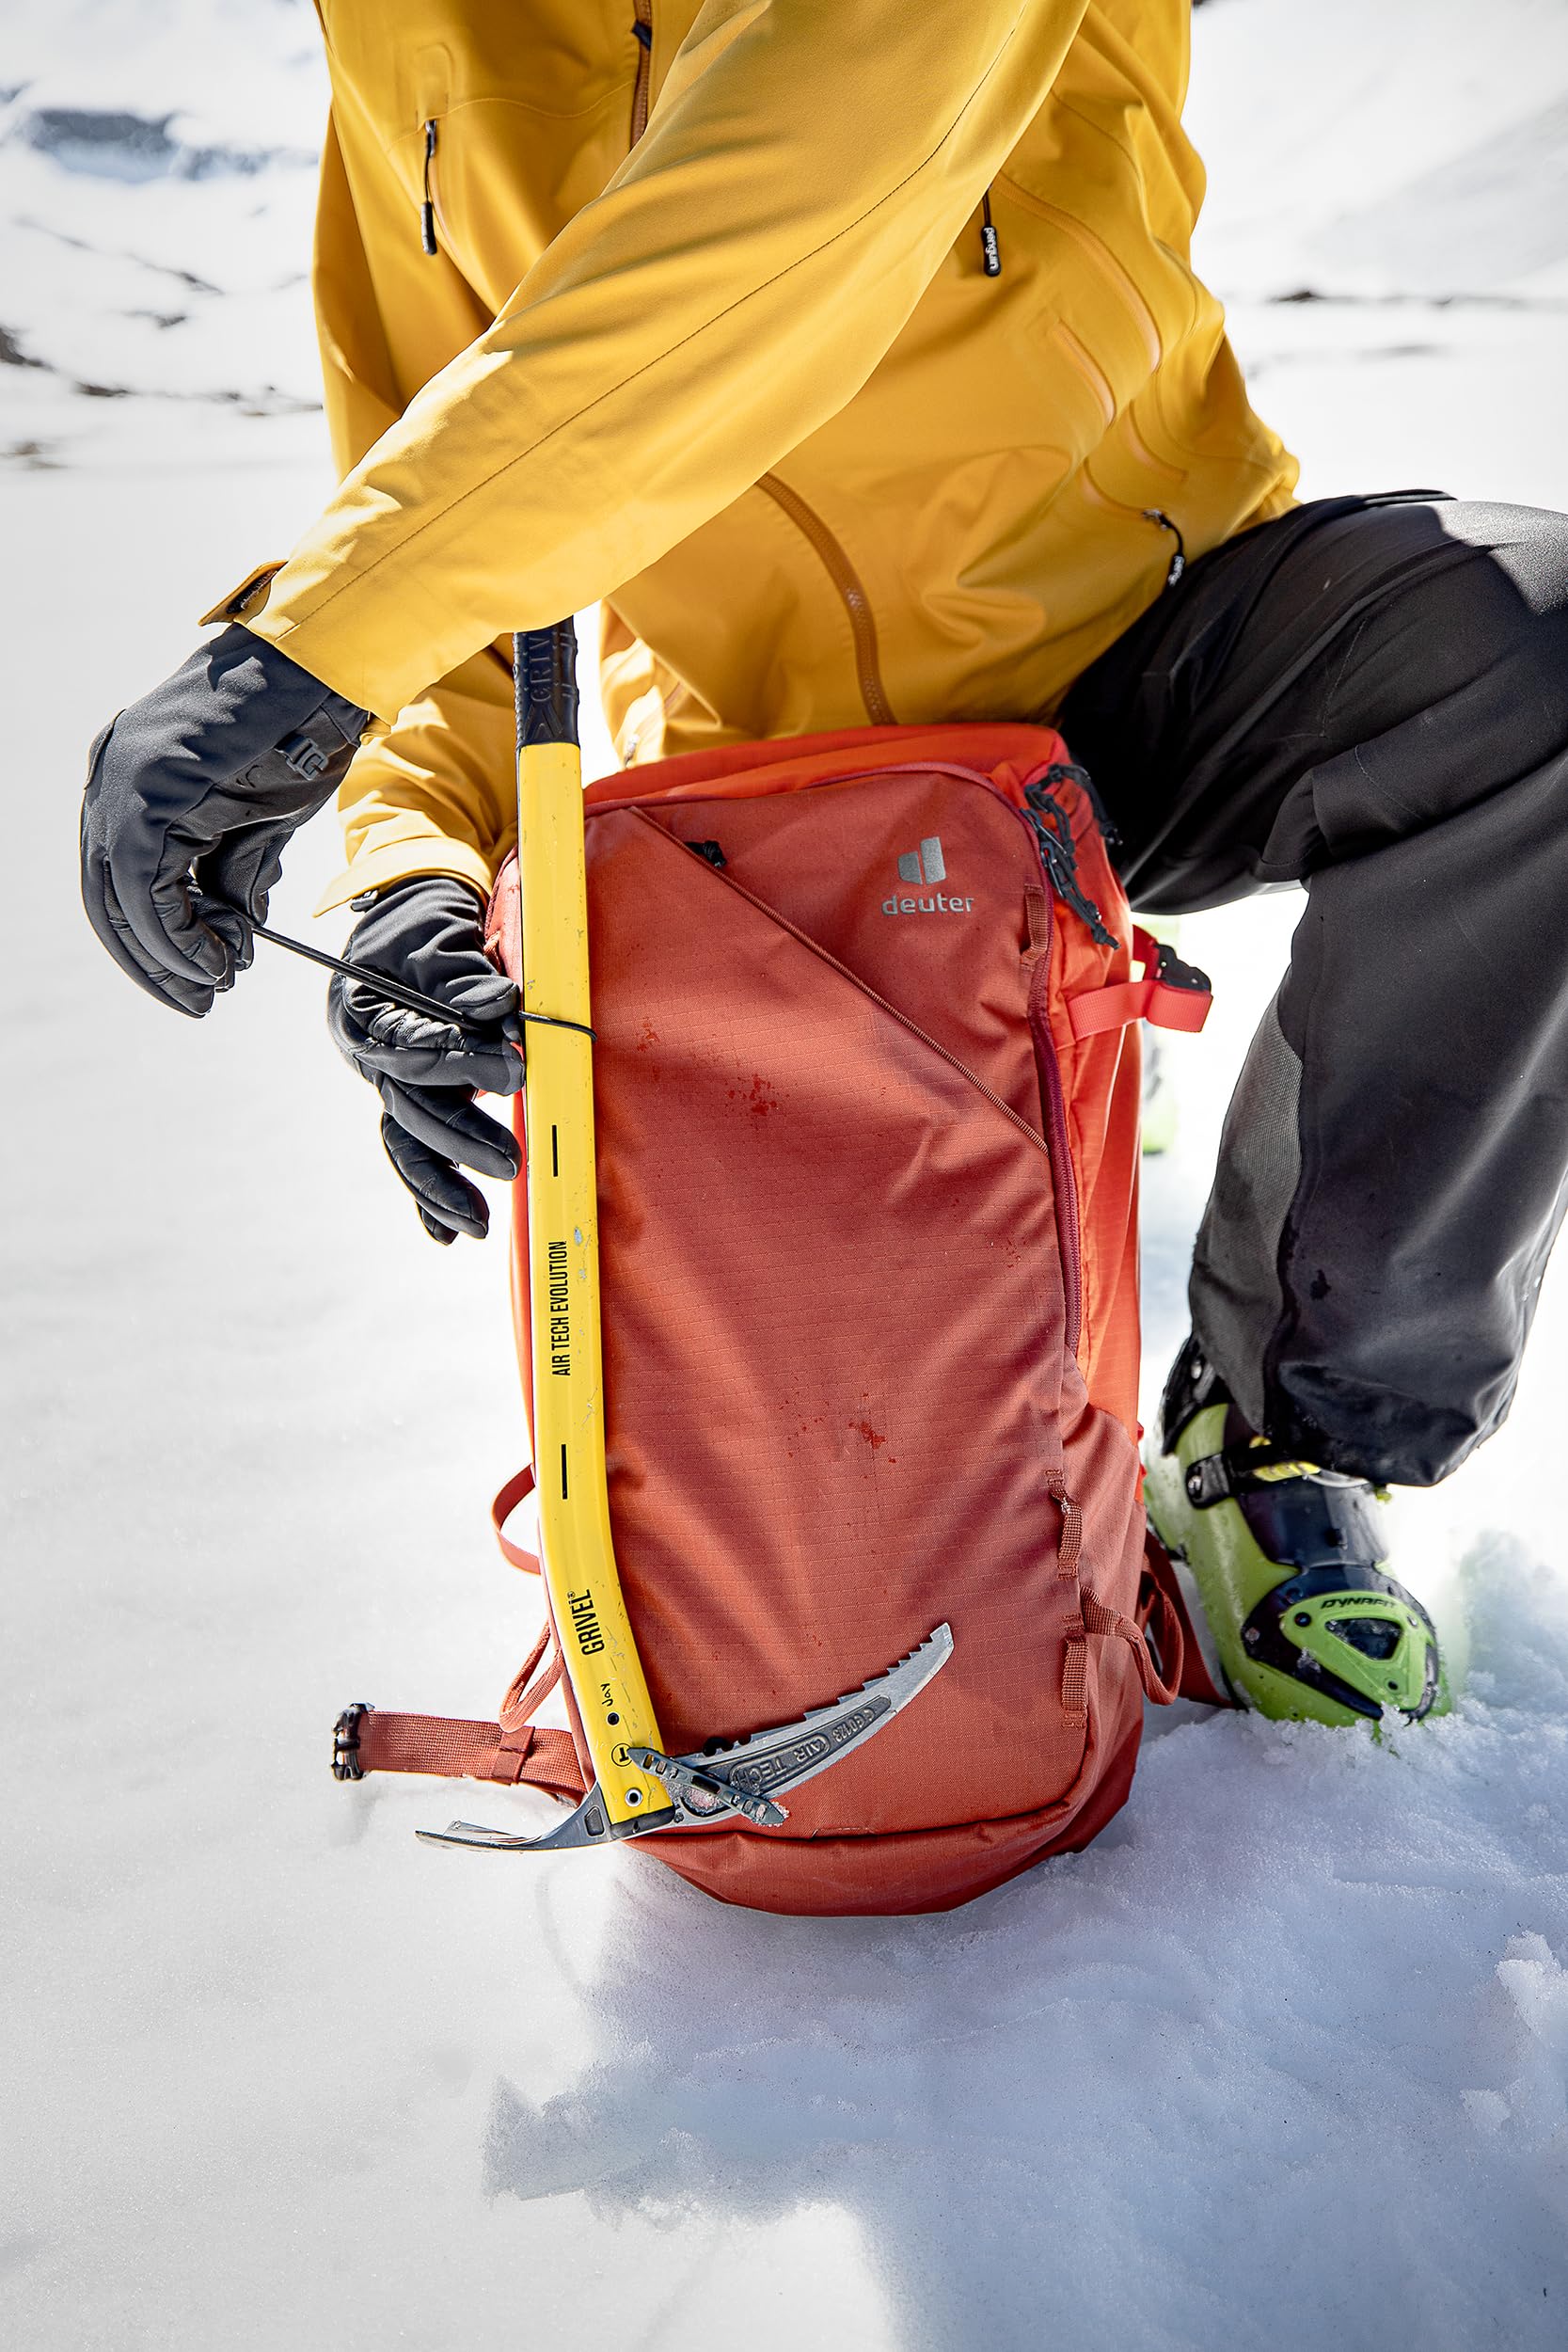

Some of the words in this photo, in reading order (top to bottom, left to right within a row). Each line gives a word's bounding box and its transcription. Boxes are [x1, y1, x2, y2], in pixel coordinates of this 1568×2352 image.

[983, 227, 999, 271] penguin
[529, 636, 551, 702] GRIV
[881, 892, 974, 915] deuter
[548, 1240, 569, 1312] EVOLUTION
[550, 1316, 570, 1351] TECH
[551, 1354, 571, 1376] AIR
[600, 1682, 614, 1707] Jay
[793, 1737, 824, 1764] AIR
